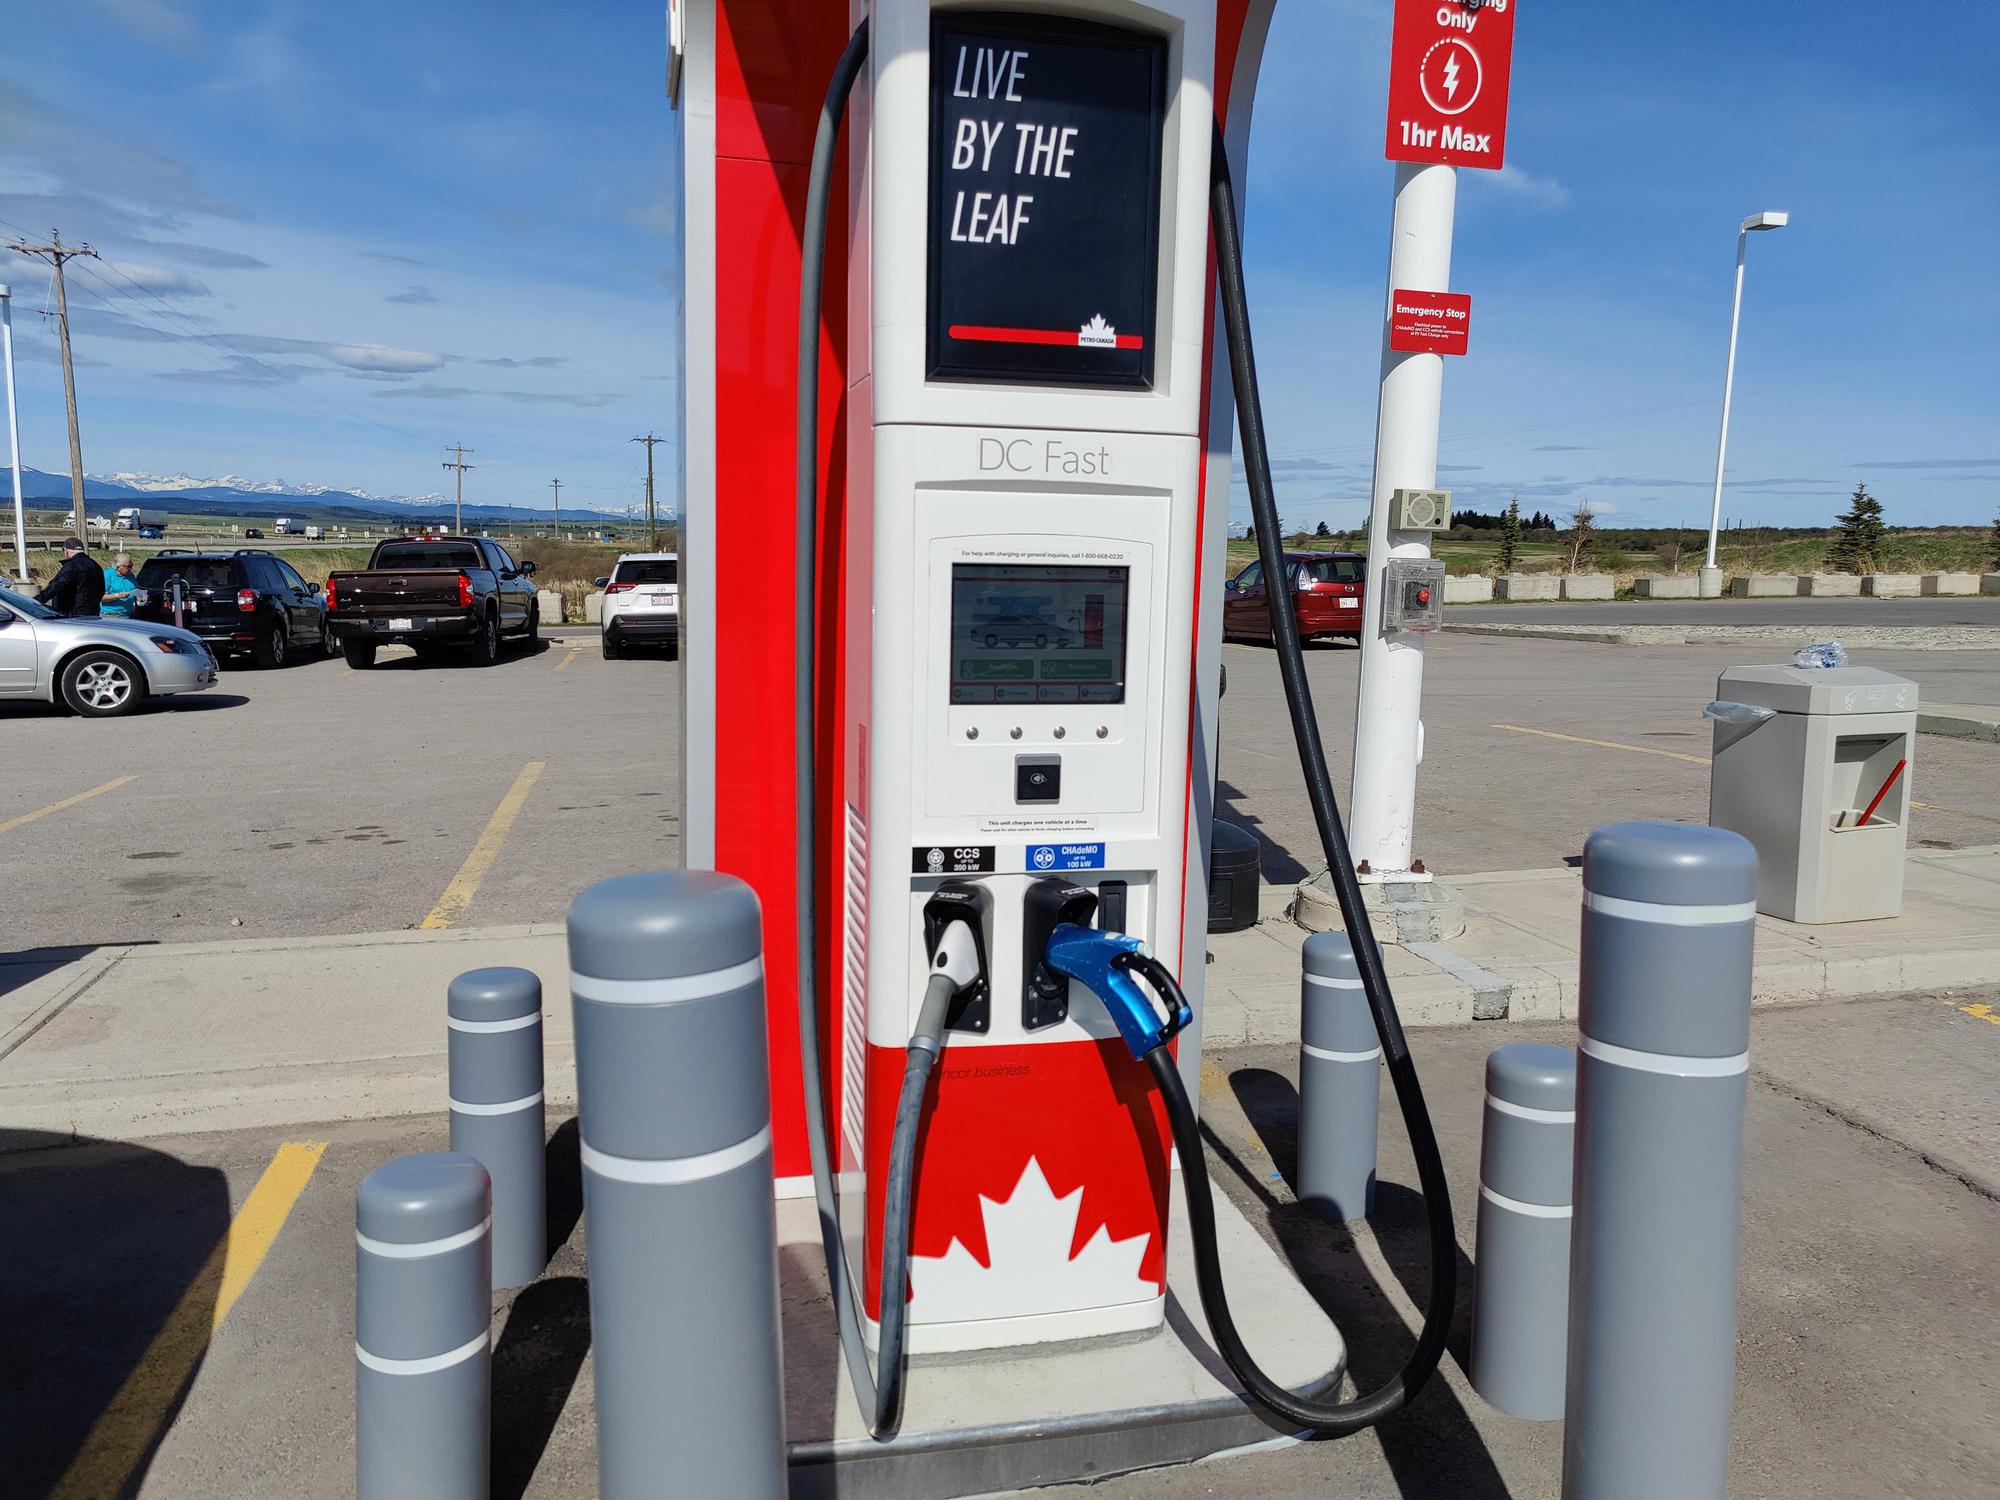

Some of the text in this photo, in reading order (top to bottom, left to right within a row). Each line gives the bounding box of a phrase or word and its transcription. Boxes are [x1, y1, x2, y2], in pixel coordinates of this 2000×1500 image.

[1436, 8, 1477, 33] Only
[953, 46, 1029, 102] LIVE
[952, 119, 1078, 178] BY THE
[1400, 121, 1492, 153] 1hr Max
[950, 192, 1034, 245] LEAF
[1396, 304, 1466, 320] Emergency Stop
[980, 438, 1110, 475] DC Fast
[954, 848, 980, 859] CCS
[1061, 845, 1098, 855] CHAdeMO
[974, 1064, 1032, 1078] business
